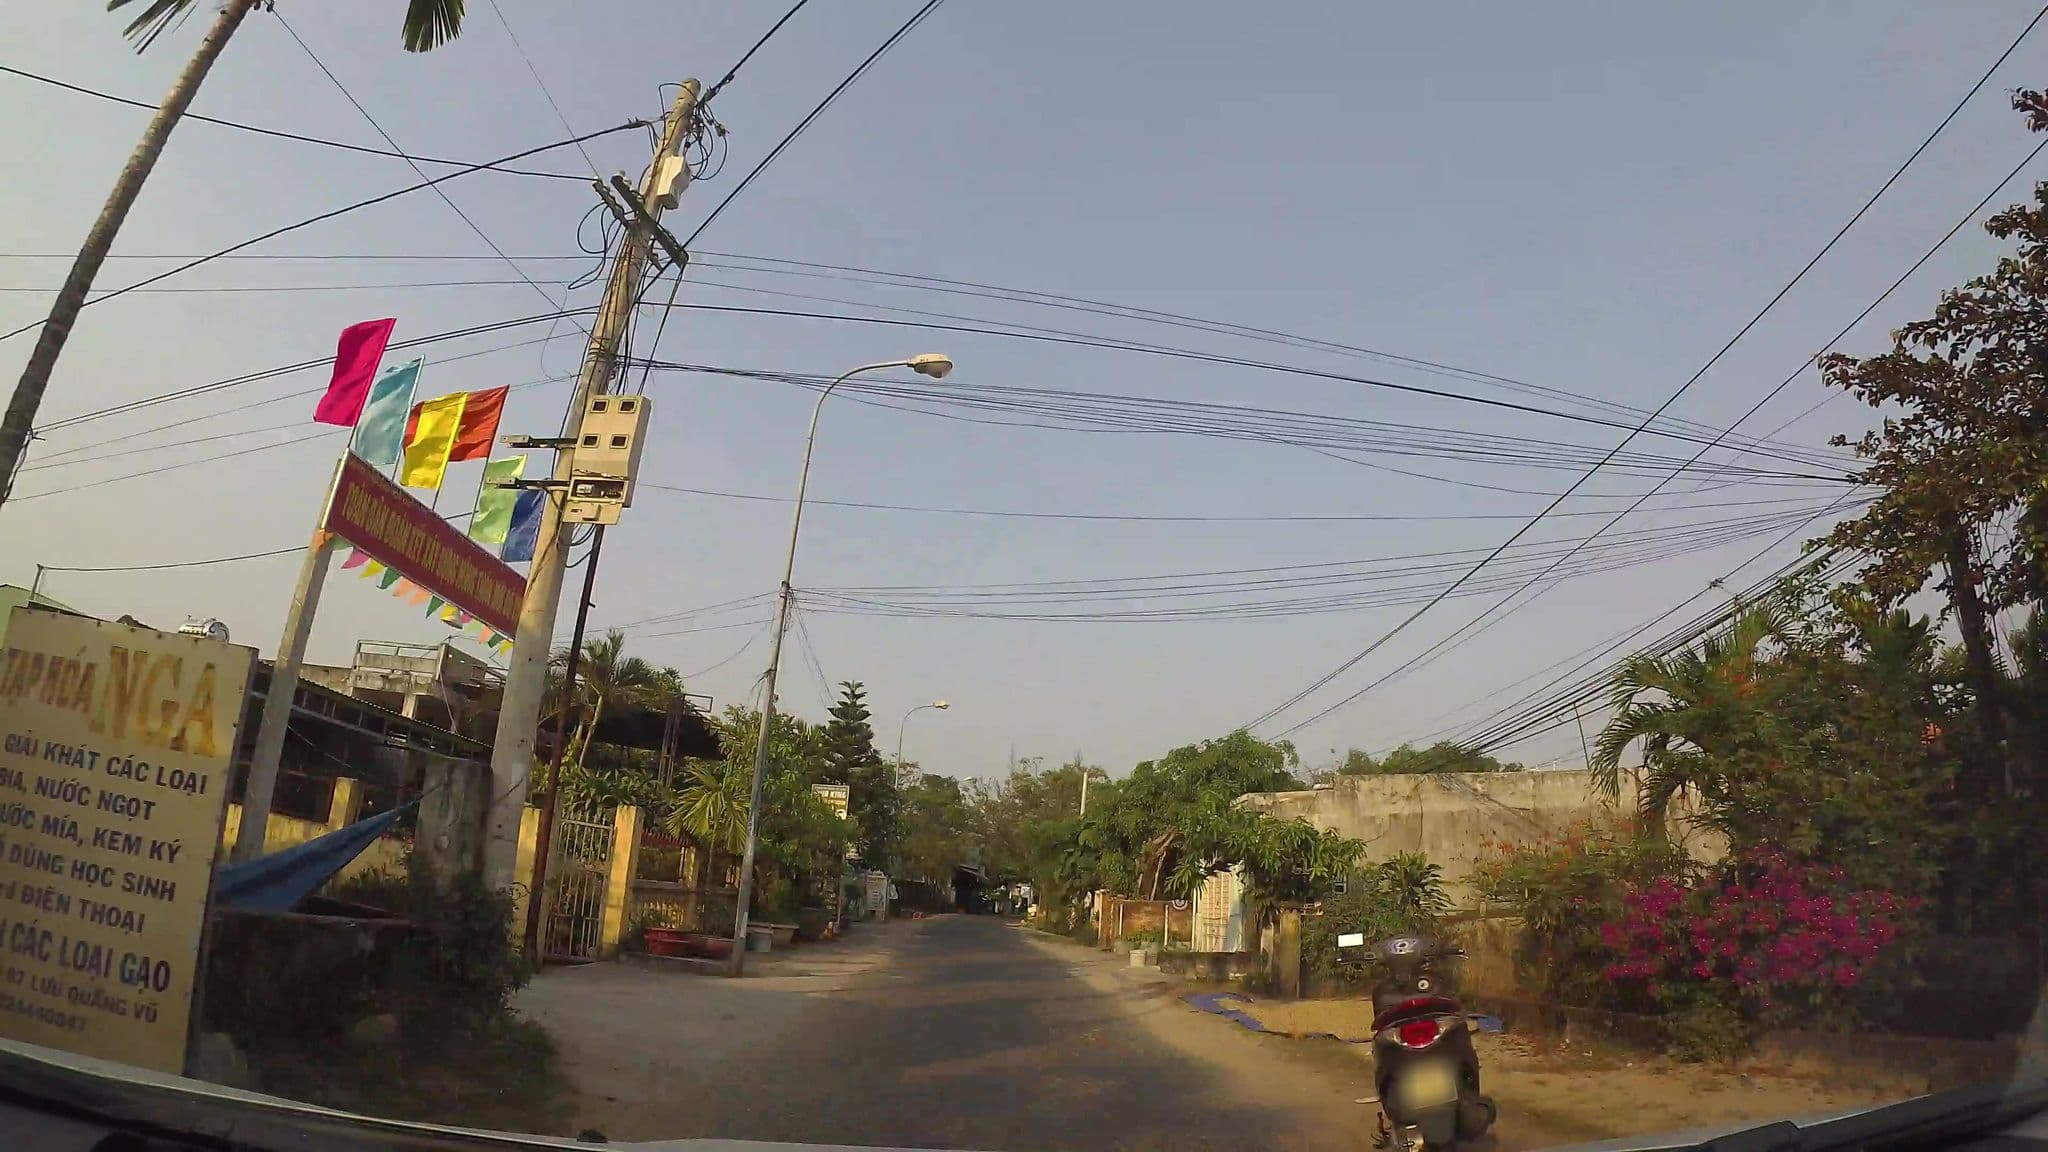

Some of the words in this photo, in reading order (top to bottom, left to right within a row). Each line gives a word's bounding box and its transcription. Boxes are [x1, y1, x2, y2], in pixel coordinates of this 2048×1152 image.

[88, 645, 217, 758] NGA
[5, 729, 39, 757] GIẢI
[44, 744, 100, 770] KHÁT
[106, 755, 150, 782] CÁC
[156, 766, 207, 796] LOẠI
[35, 776, 91, 807] NƯỚC
[97, 790, 156, 821] NGỌT
[41, 813, 84, 848] MÍA,
[92, 826, 143, 856] KEM
[149, 838, 182, 864] KÝ
[71, 860, 116, 888] HỌC
[121, 871, 177, 902] SINH
[79, 898, 146, 934] THOẠI
[10, 918, 53, 963] CÁC
[58, 935, 114, 981] LOẠI
[119, 951, 171, 995] GẠO
[134, 1000, 159, 1023] VŨ
